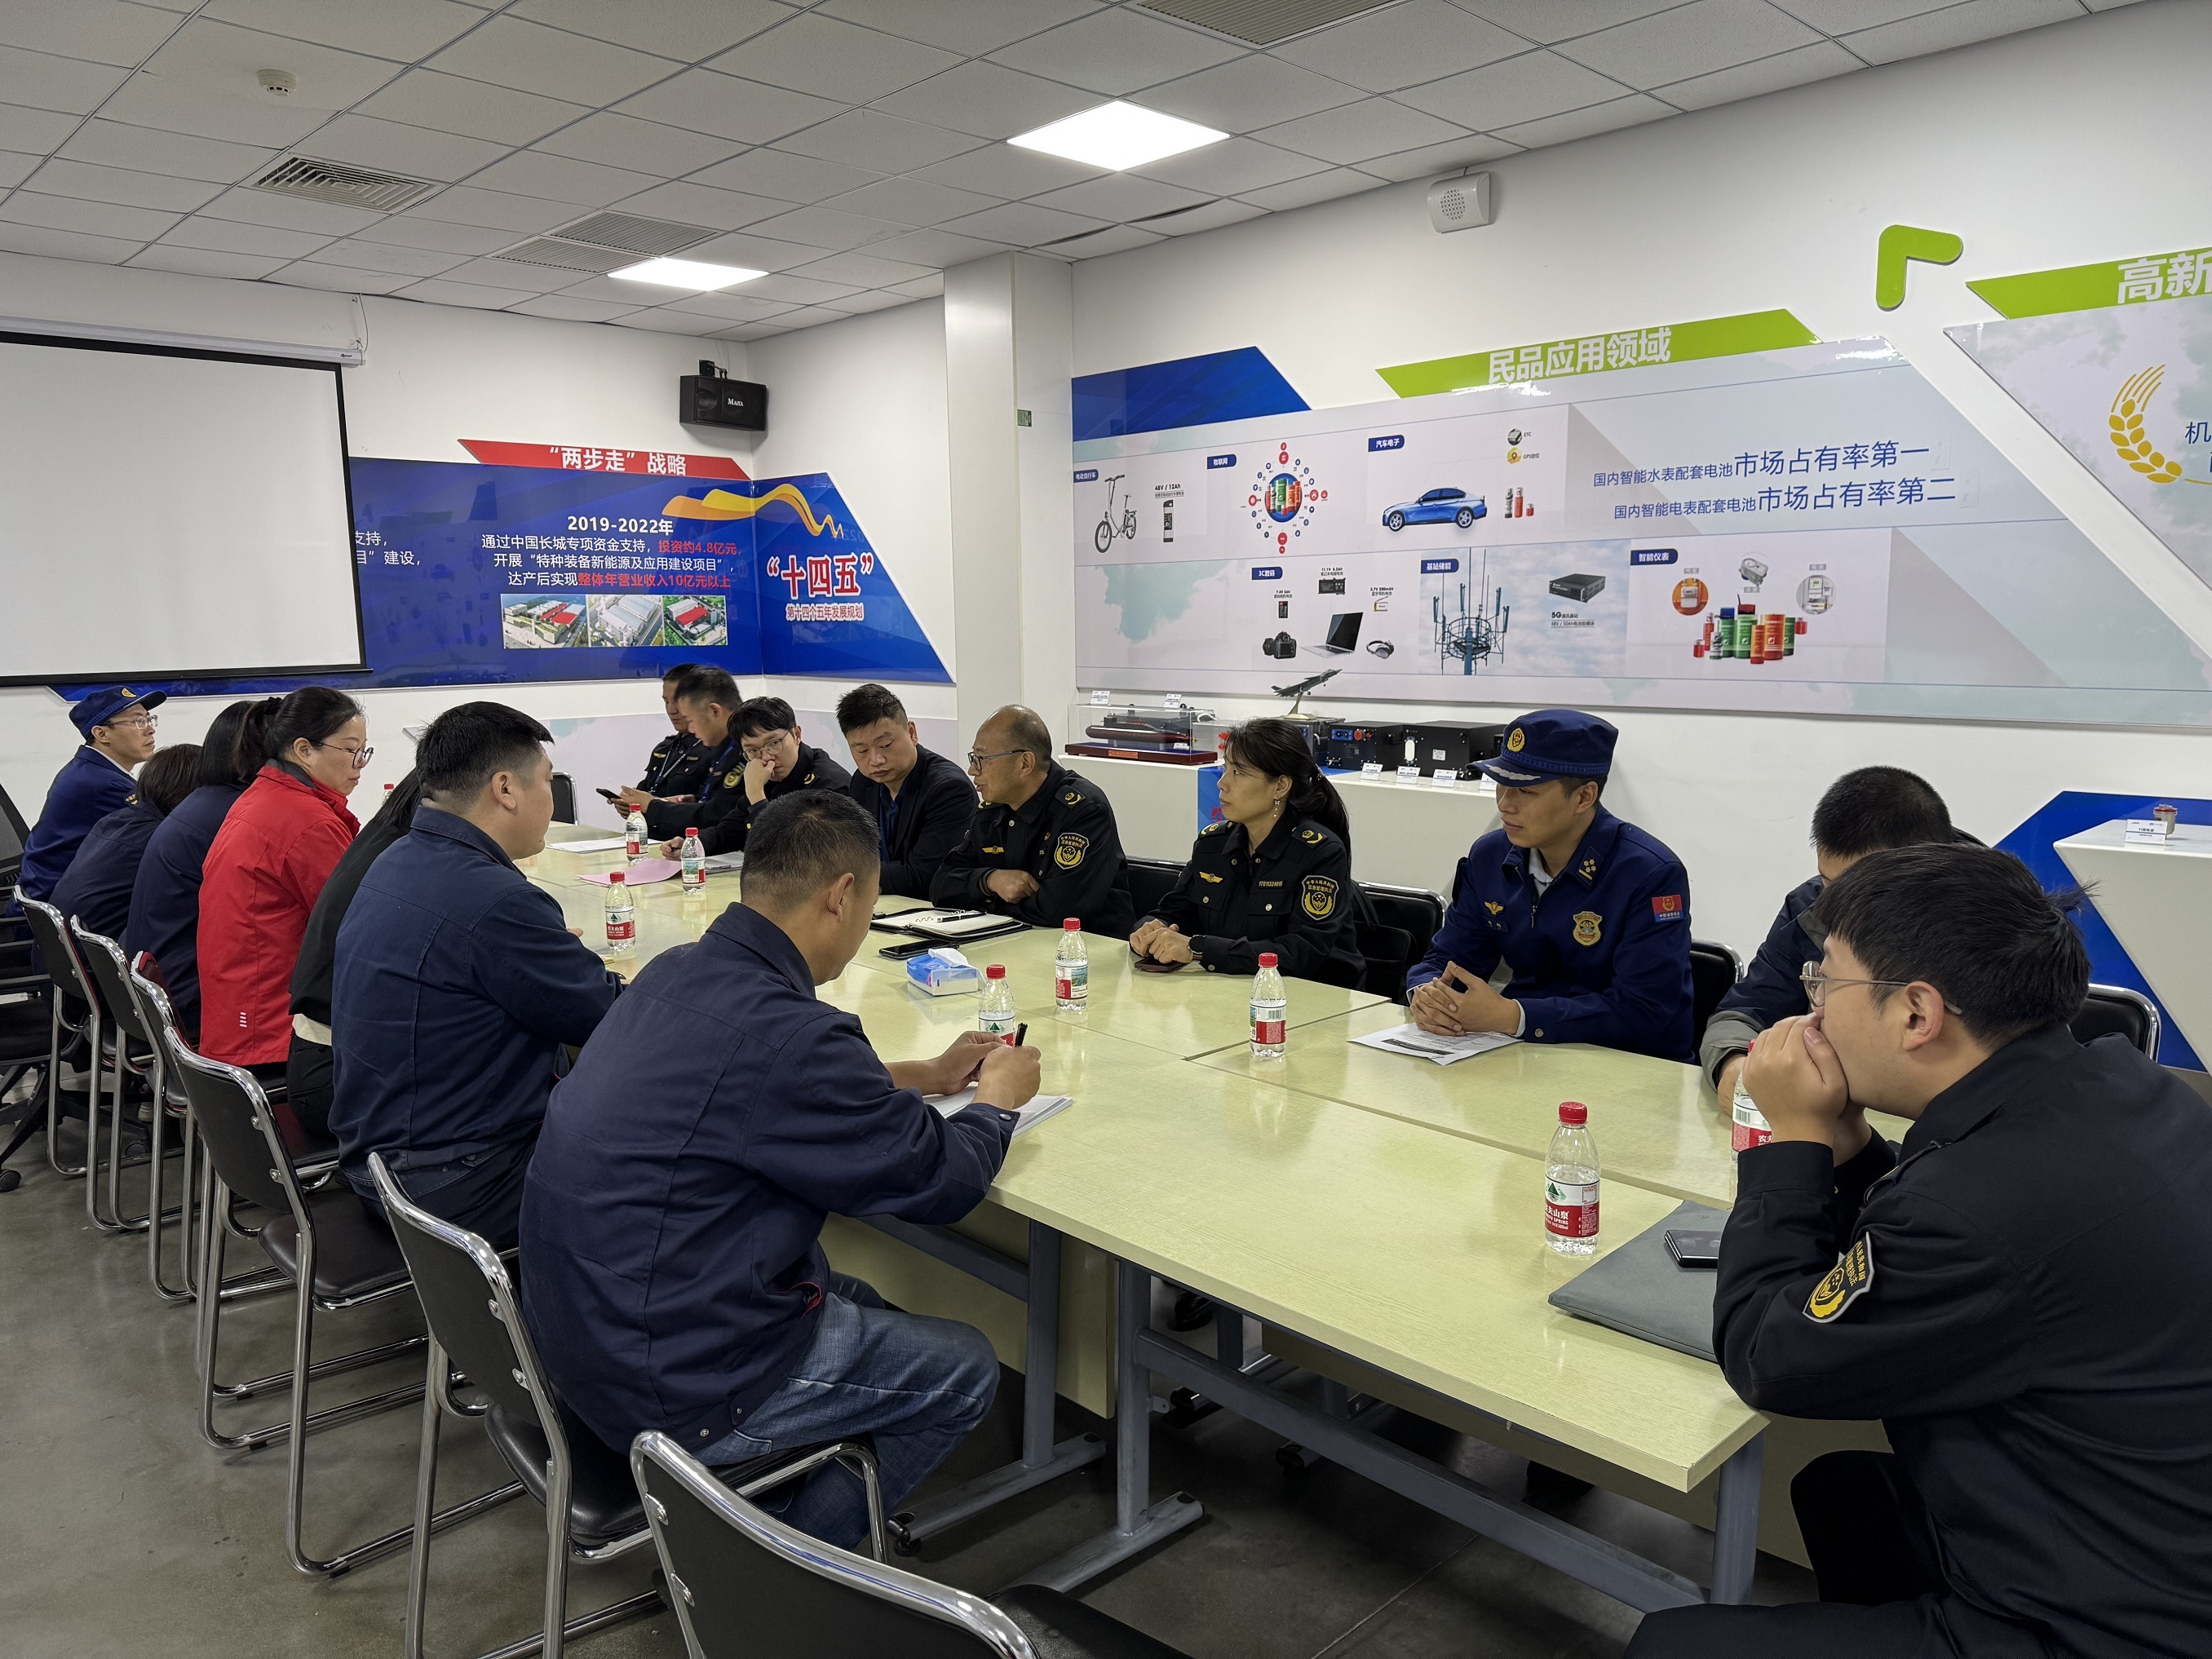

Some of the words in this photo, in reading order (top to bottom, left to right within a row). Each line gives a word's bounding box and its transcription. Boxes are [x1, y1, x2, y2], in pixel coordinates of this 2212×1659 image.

[1489, 326, 1671, 384] 民品应用领域
[1375, 438, 1400, 449] 汽车电子
[1213, 458, 1228, 467] 物联网
[1593, 440, 1930, 488] 国内智能水表配套电池市场占有率第一
[1075, 471, 1097, 480] 电动自行车
[1613, 476, 1956, 520] 国内智能电表配套电池市场占有率第二
[568, 515, 674, 535] 2019-2022年
[1639, 552, 1670, 562] 智能仪表
[1427, 561, 1452, 570] 基站储能
[508, 571, 731, 589] 达产后实现整体年营业收入10亿元以上
[1258, 569, 1276, 577] 3C数码
[785, 603, 864, 621] 第十四个五年发展规划
